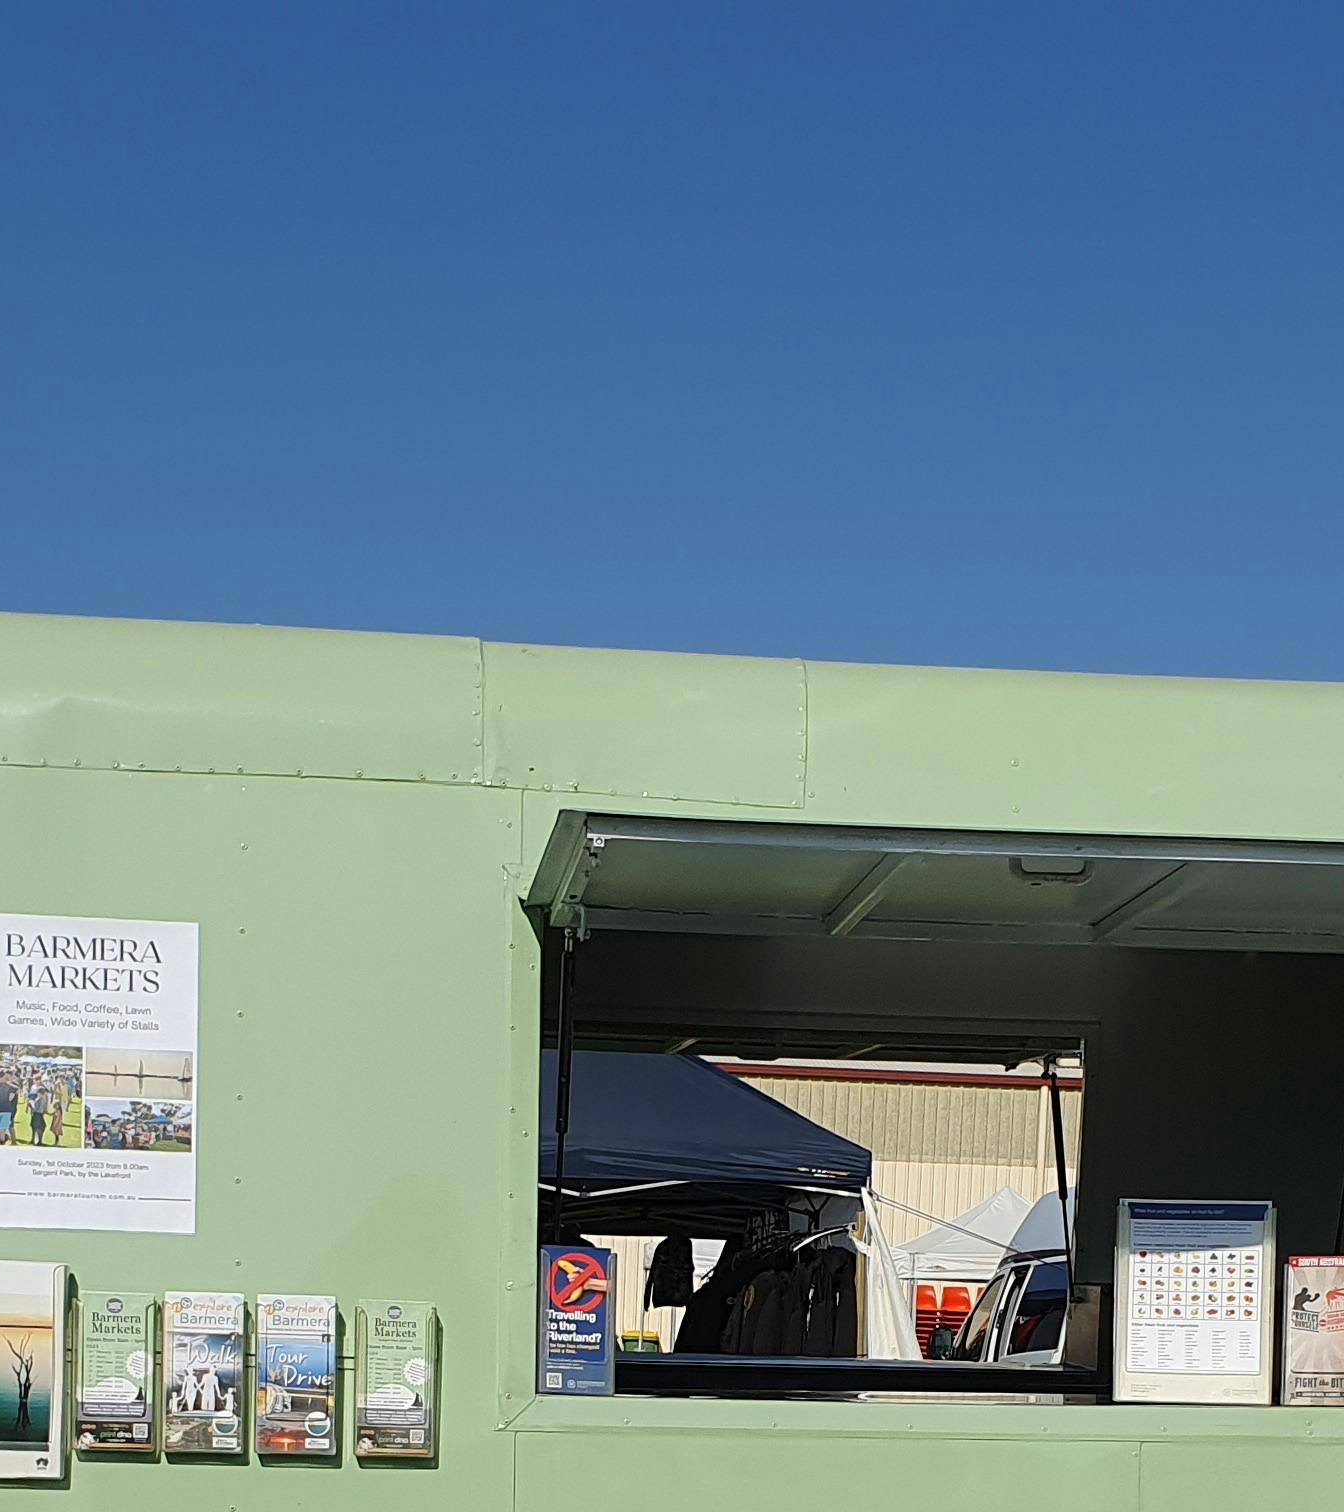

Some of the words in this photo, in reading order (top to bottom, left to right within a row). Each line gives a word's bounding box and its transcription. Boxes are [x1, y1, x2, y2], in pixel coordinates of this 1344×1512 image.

[6, 933, 162, 963] BARMERA
[8, 963, 160, 993] MARKETS
[16, 1000, 49, 1012] Music,
[52, 1002, 81, 1014] Food,
[84, 1003, 122, 1015] Coffee,
[125, 1005, 152, 1015] Lawn
[7, 1014, 48, 1027] Games,
[50, 1016, 77, 1027] Wide
[80, 1018, 115, 1031] Variety
[118, 1020, 128, 1029] of
[131, 1020, 159, 1031] Stalls
[193, 1299, 233, 1315] explore
[286, 1302, 325, 1317] explore
[92, 1312, 141, 1324] Barmera
[180, 1312, 239, 1326] Barmera
[272, 1315, 330, 1327] Barmera
[375, 1317, 417, 1329] Barmera
[547, 1310, 596, 1323] Travelling
[92, 1322, 141, 1335] Markets
[374, 1327, 417, 1338] Markets
[559, 1321, 577, 1331] the
[548, 1332, 602, 1343] Riverland?
[187, 1341, 236, 1365] Walk
[267, 1344, 309, 1364] Tour
[283, 1365, 333, 1386] Drive
[1294, 1377, 1318, 1388] FIGHT
